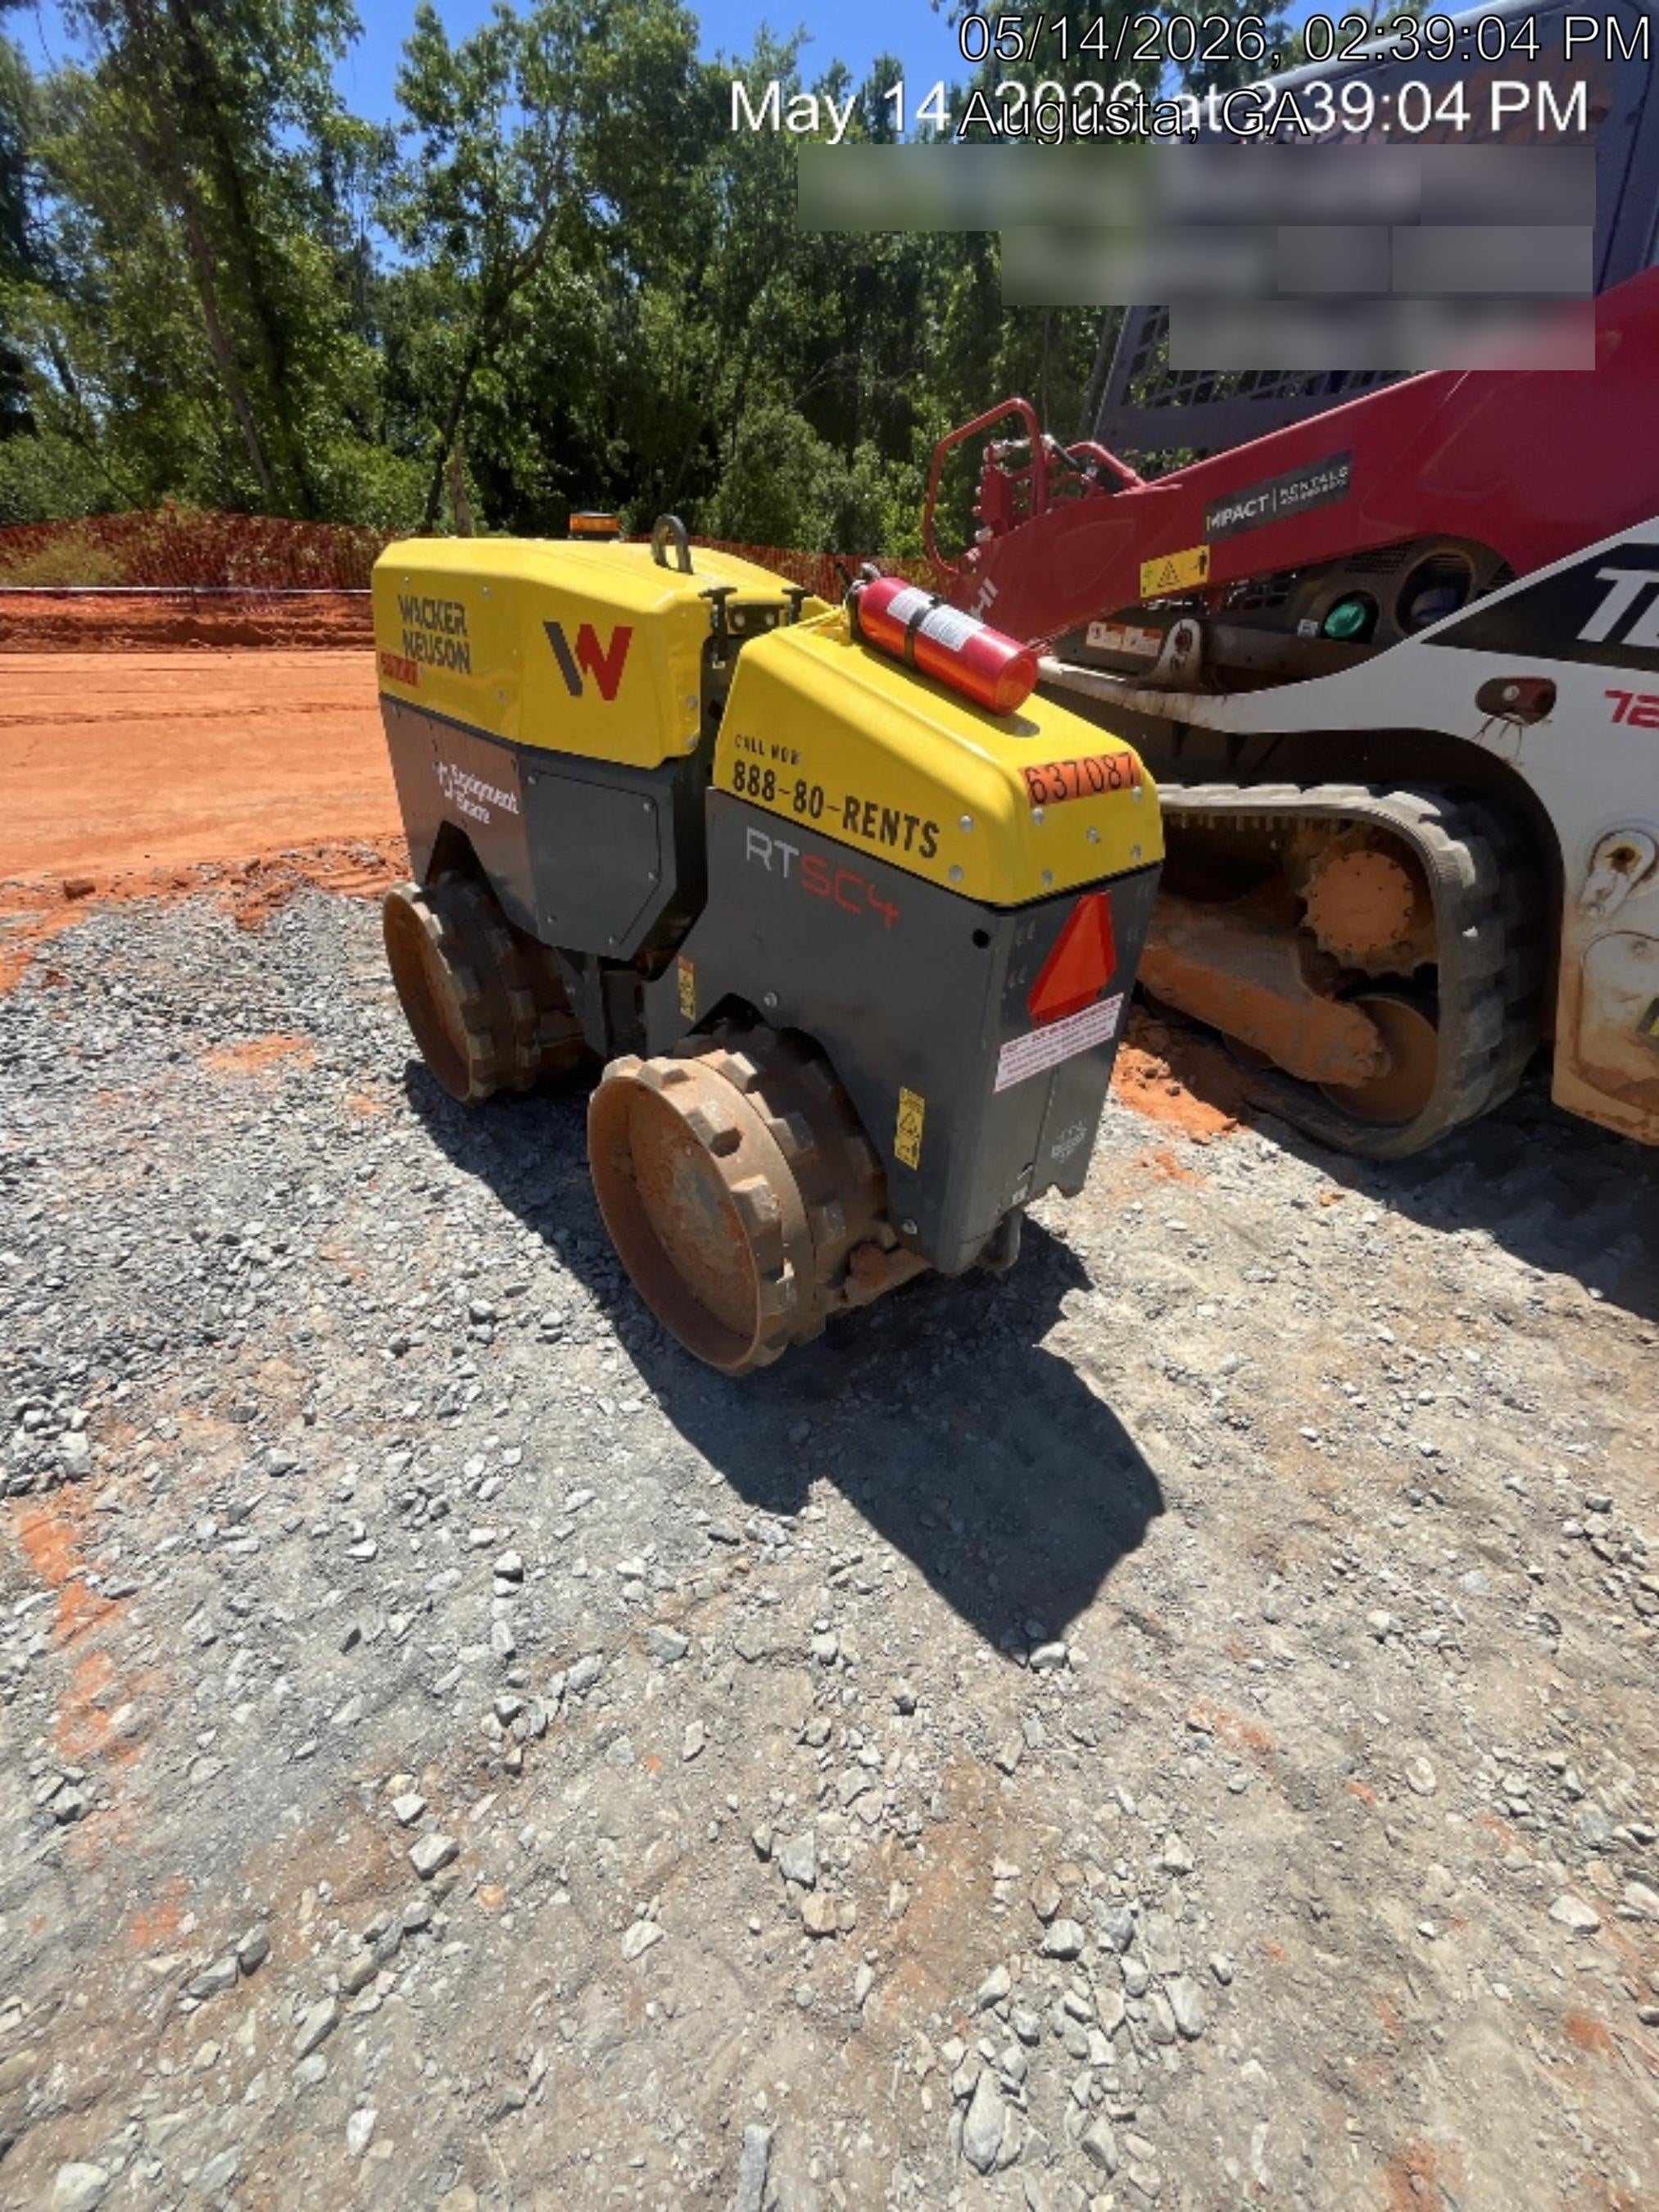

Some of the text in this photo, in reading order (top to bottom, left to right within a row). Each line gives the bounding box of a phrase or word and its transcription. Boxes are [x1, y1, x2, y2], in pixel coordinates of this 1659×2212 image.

[1206, 493, 1269, 532] IMPACT
[397, 594, 468, 637] WACKER
[402, 628, 471, 674] NEUSON
[734, 734, 801, 766] CALL NOW
[1026, 751, 1135, 805] 637087
[733, 759, 940, 859] 888-80-RENTS
